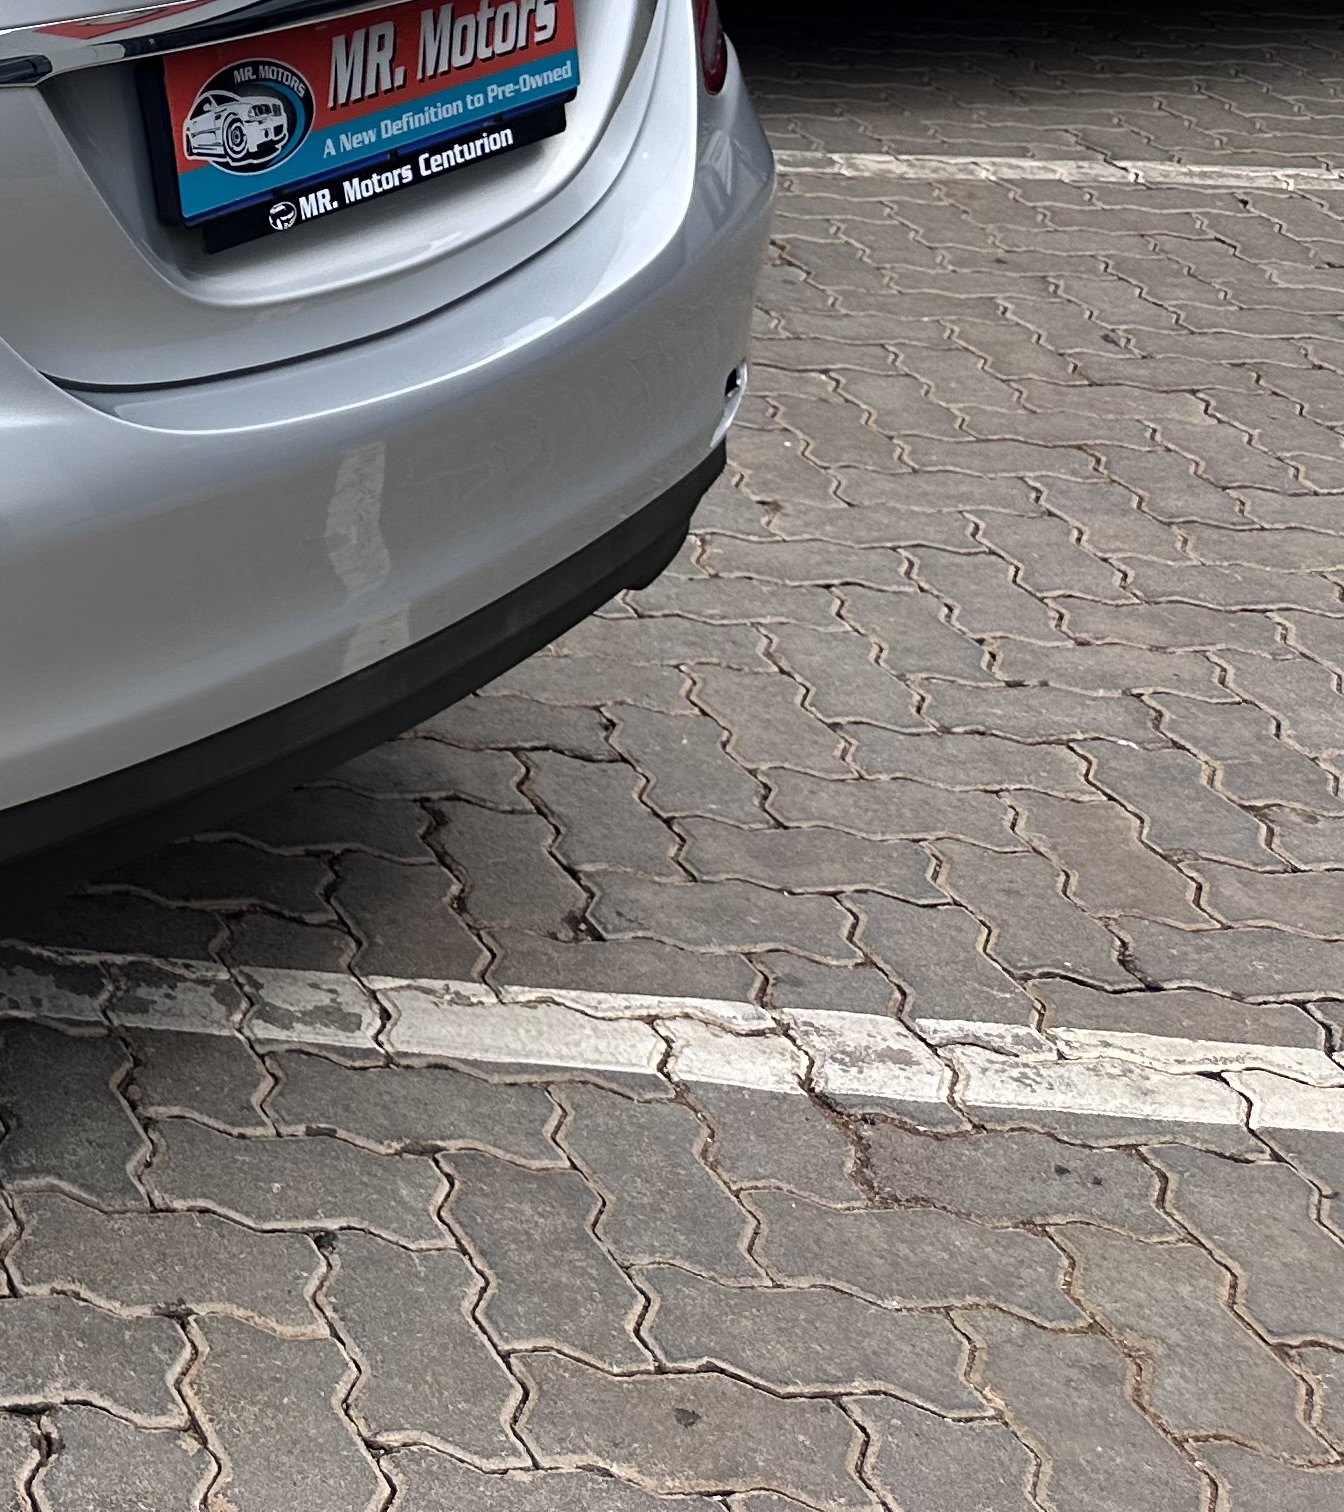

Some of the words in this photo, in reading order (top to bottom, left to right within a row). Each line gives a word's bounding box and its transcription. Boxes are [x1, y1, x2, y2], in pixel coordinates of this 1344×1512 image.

[233, 66, 257, 85] MR.
[258, 64, 307, 98] MOTORS
[323, 138, 336, 158] A
[339, 132, 377, 152] New
[380, 100, 463, 139] Definition
[466, 93, 484, 109] to
[487, 60, 572, 103] Pre-Owned
[327, 21, 407, 110] MR.
[298, 189, 338, 221] MR.
[343, 164, 413, 204] Motors
[418, 128, 514, 177] Centurion
